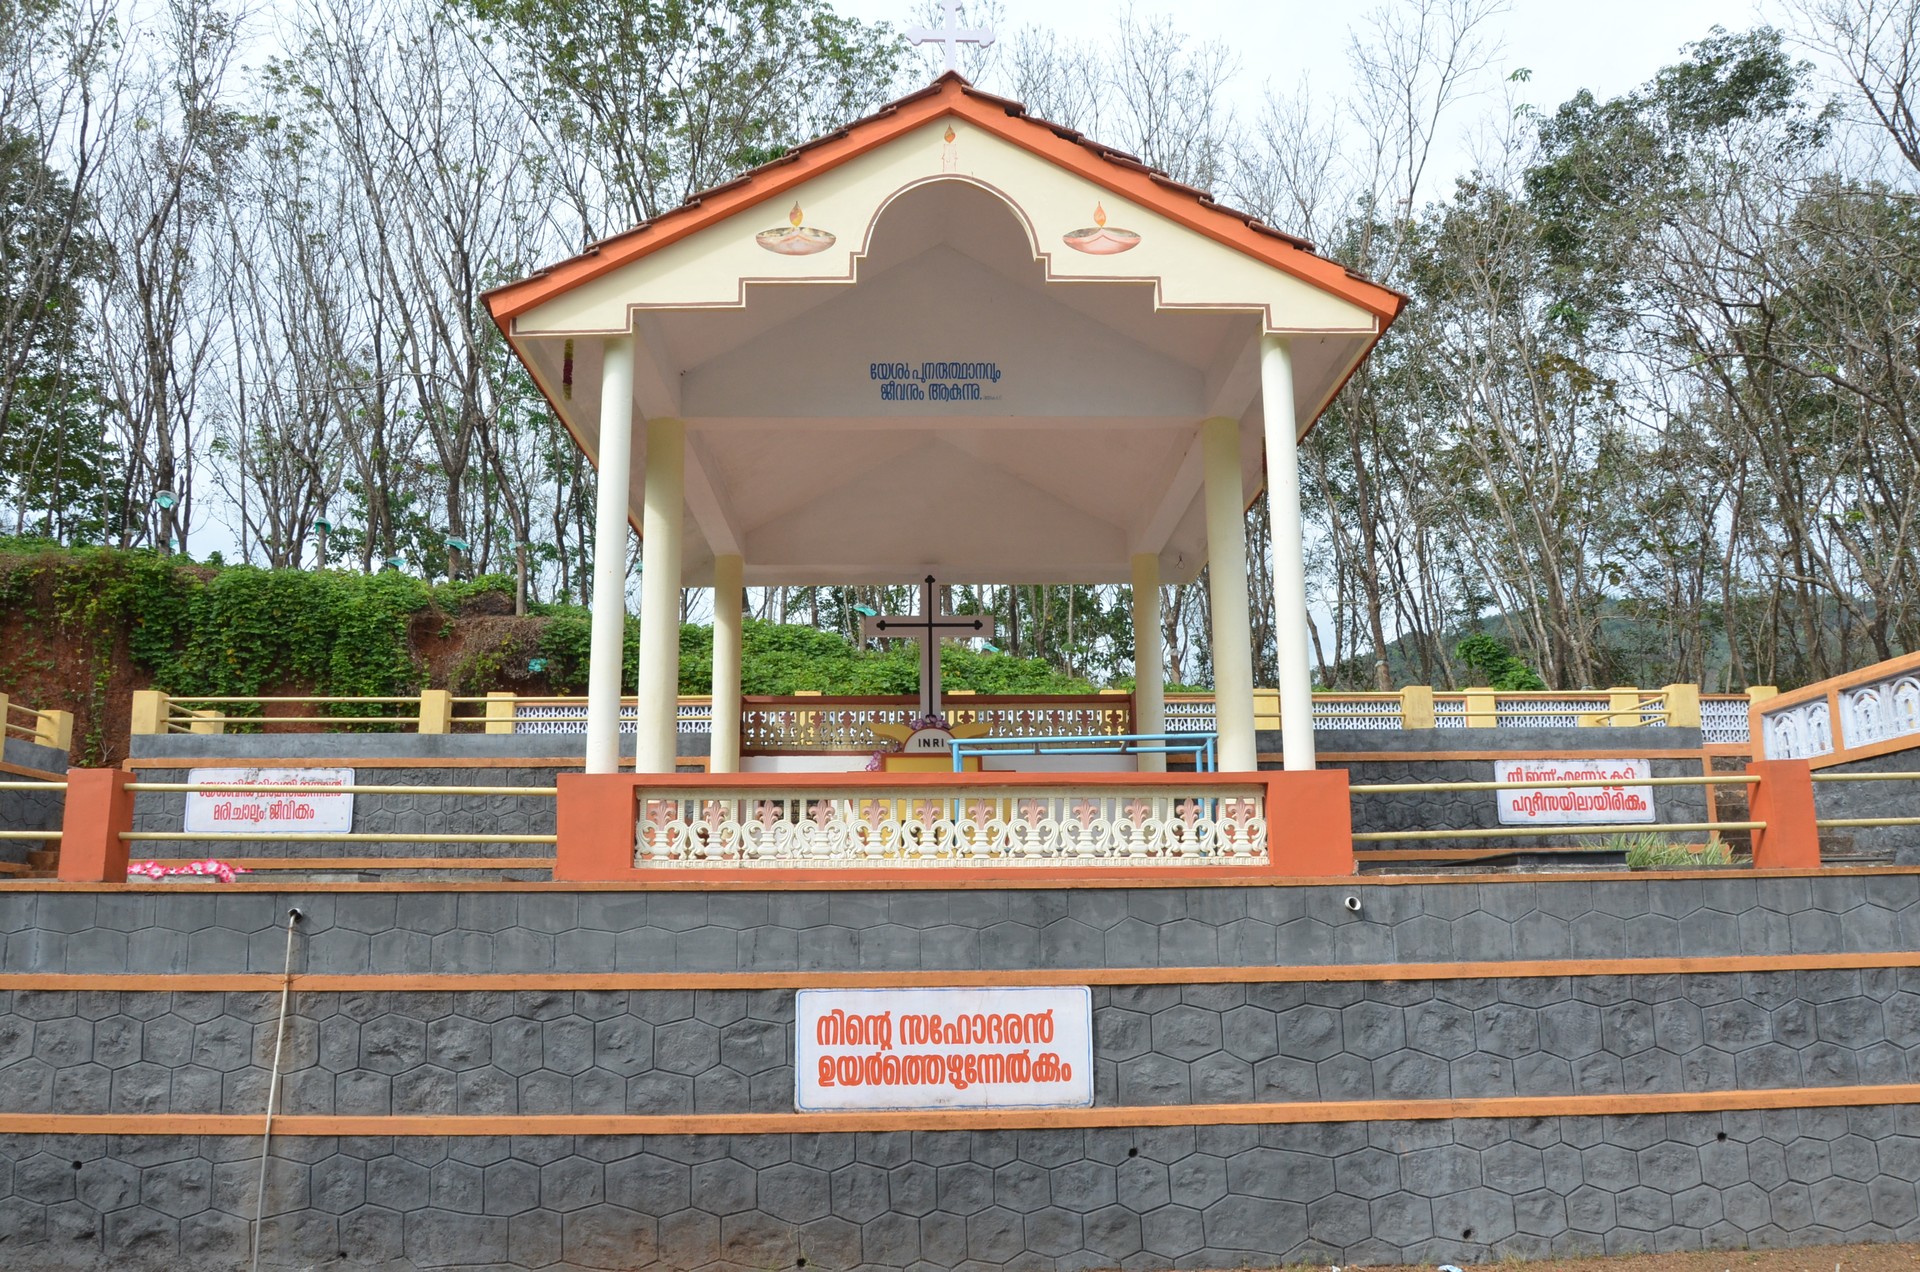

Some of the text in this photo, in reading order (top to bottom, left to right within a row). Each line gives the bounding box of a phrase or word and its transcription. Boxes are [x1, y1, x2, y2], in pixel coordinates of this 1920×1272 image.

[881, 381, 925, 401] ജീവനും
[918, 738, 945, 748] INRI
[900, 1009, 1054, 1045] സഹോദരൻ
